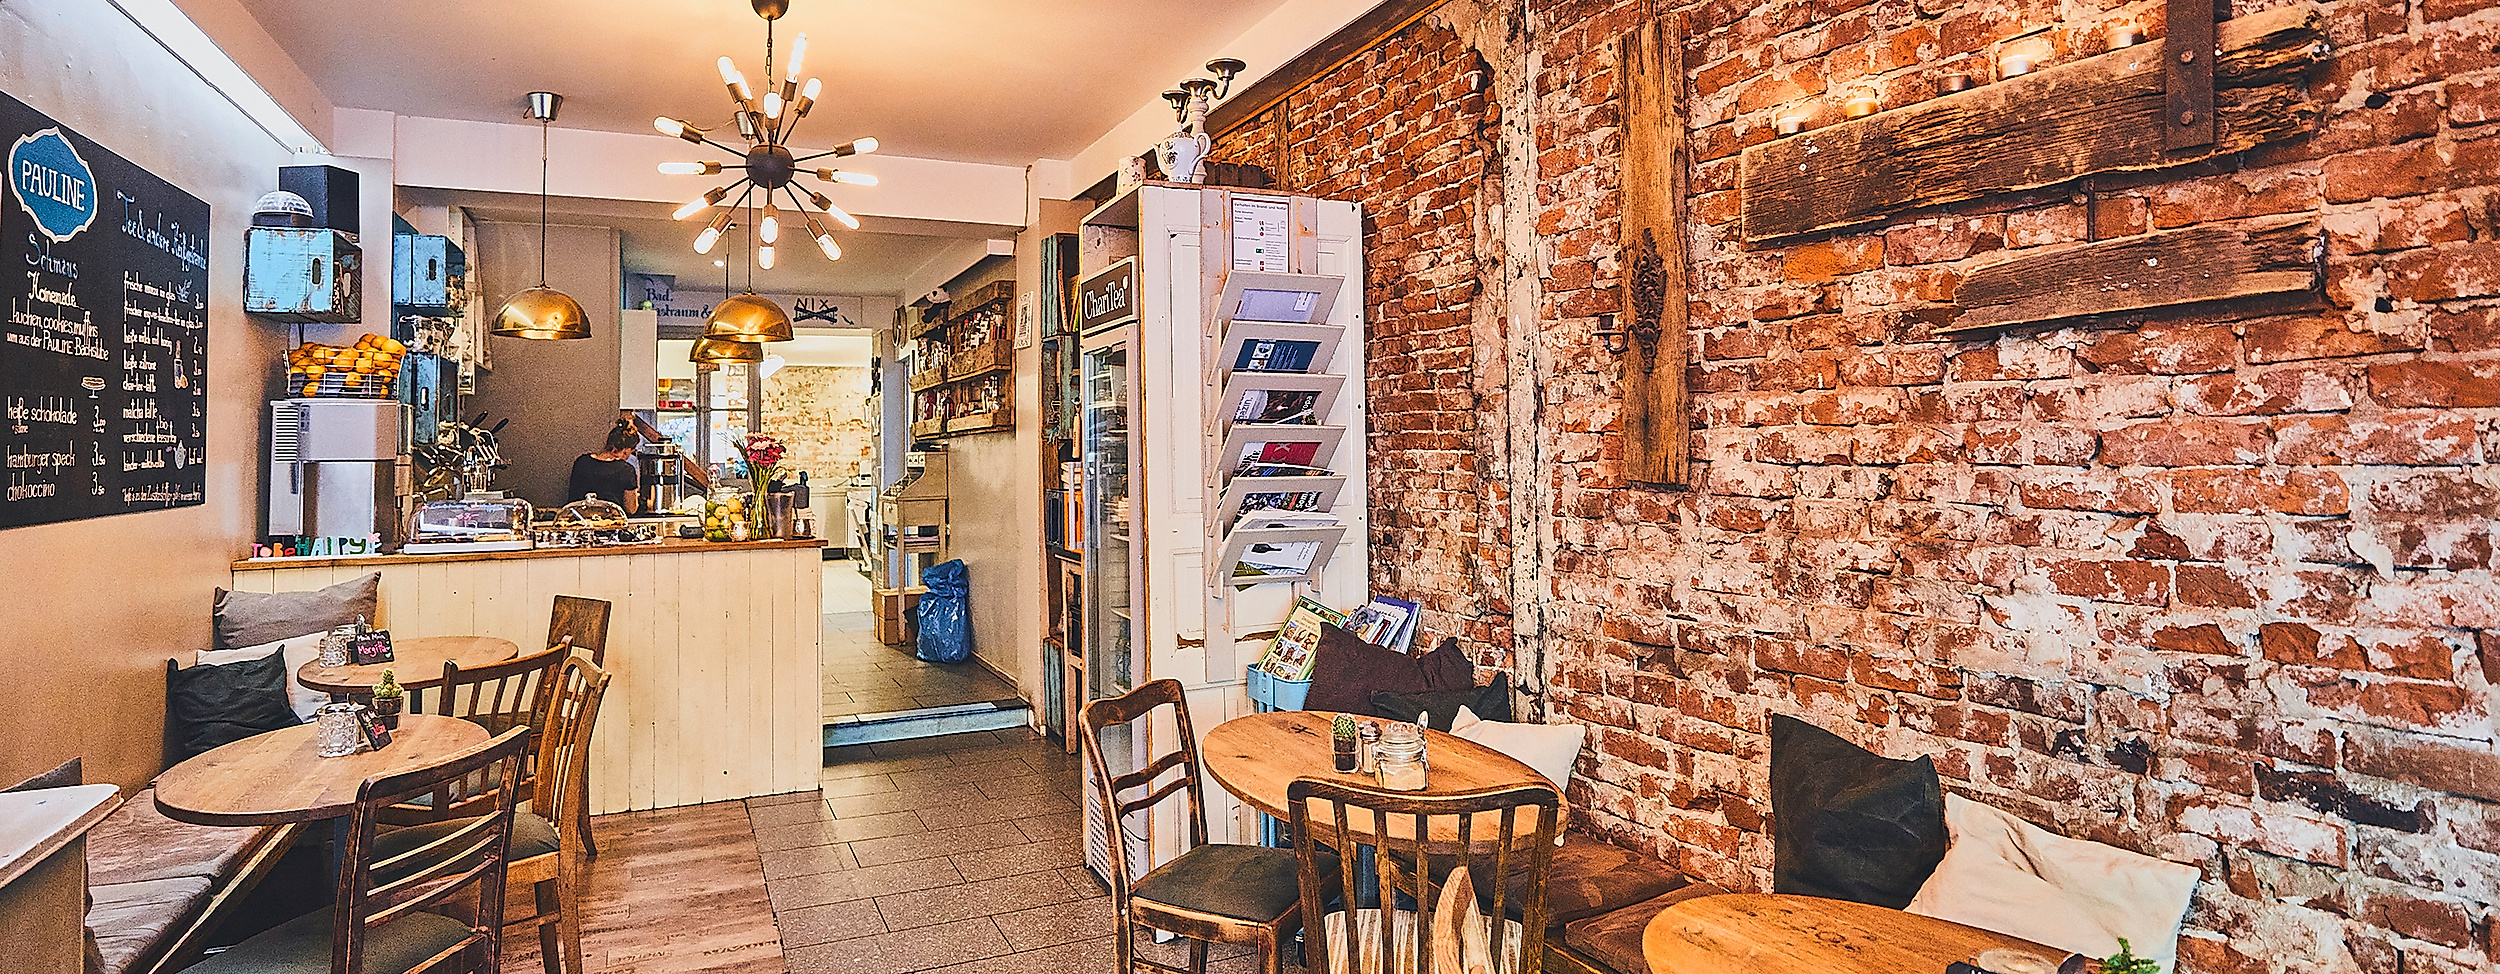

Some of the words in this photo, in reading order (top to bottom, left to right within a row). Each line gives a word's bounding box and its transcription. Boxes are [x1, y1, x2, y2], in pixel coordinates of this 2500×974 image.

[22, 159, 85, 211] PAULINE
[25, 231, 79, 280] Schmaus
[796, 297, 829, 311] NIX
[1084, 281, 1127, 320] ChariTea
[19, 334, 30, 347] aus
[31, 326, 42, 348] der
[7, 395, 29, 427] heiße
[30, 395, 78, 425] schokolade
[6, 443, 50, 476] hamburger
[51, 439, 77, 477] speck
[6, 470, 56, 502] chokoccino
